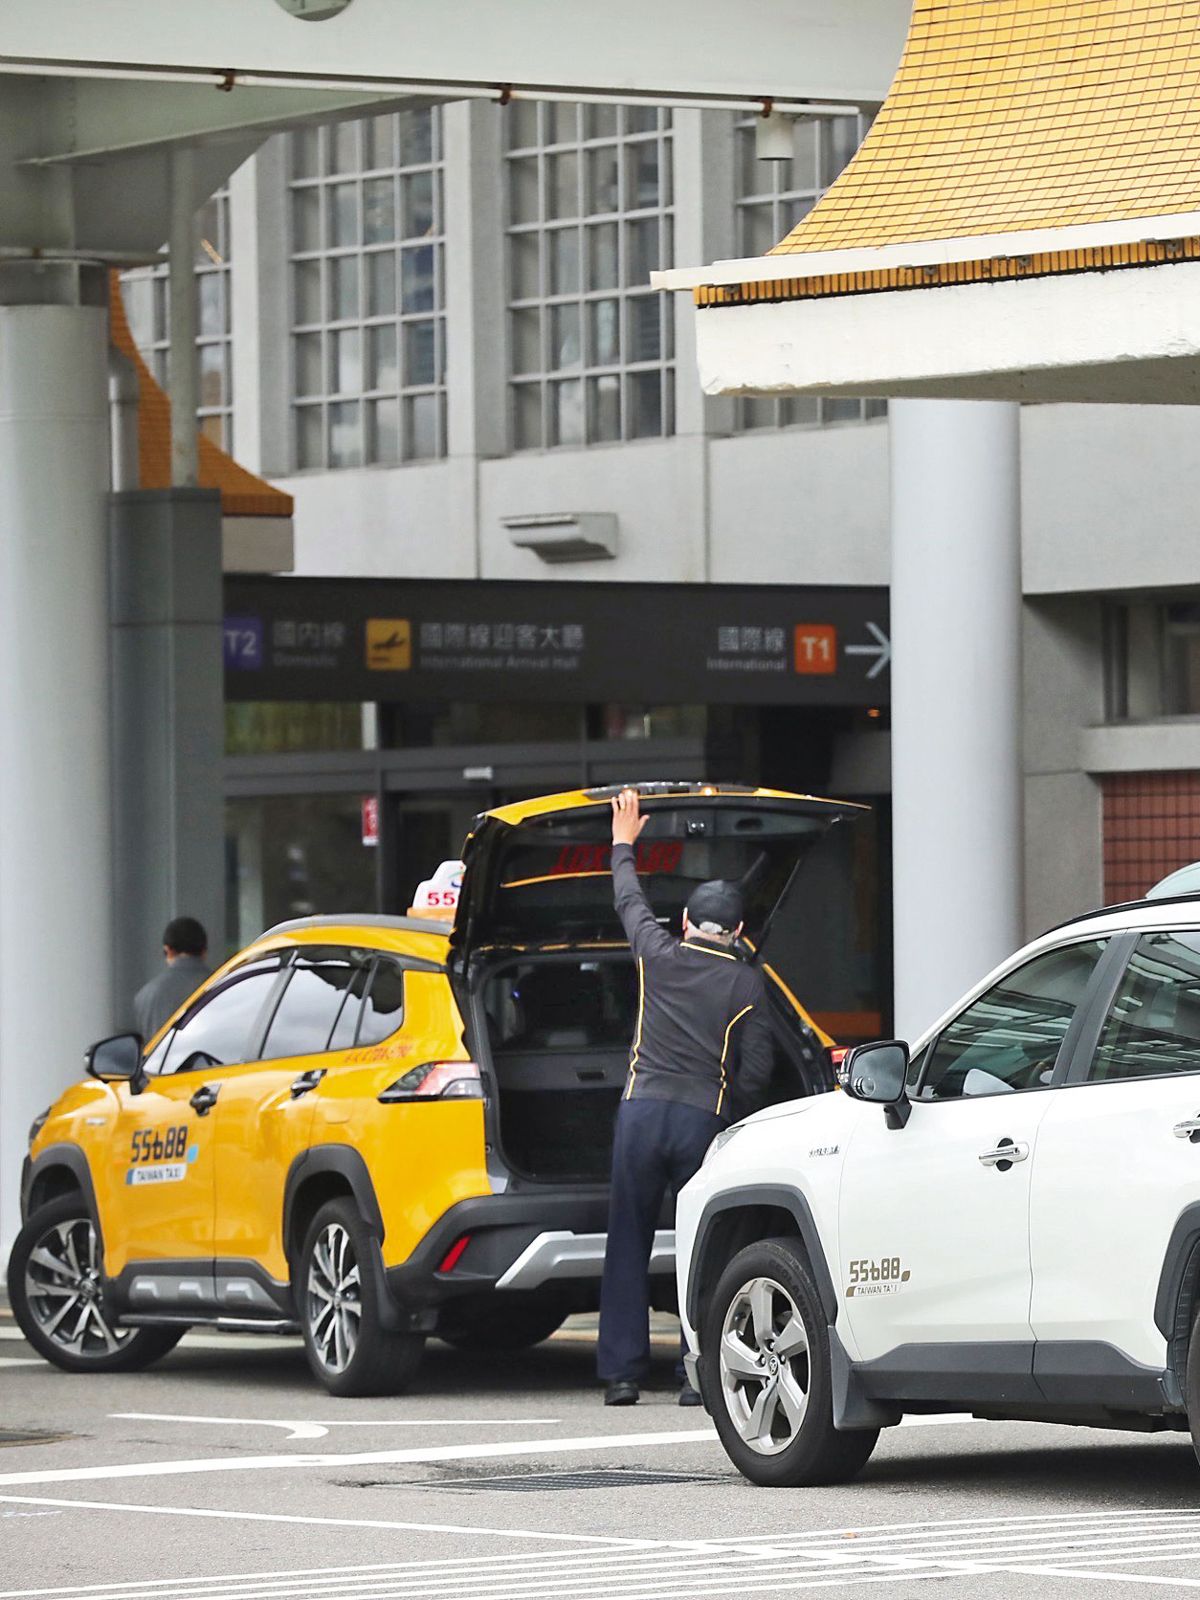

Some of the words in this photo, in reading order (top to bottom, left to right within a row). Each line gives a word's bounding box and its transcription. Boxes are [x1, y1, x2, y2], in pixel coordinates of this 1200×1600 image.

[225, 631, 257, 656] T2
[718, 626, 786, 652] 國際線
[801, 636, 832, 662] T1
[420, 655, 502, 669] International
[506, 655, 550, 669] Arrival
[553, 655, 579, 669] Hall
[706, 657, 786, 671] International
[428, 891, 456, 906] 55
[131, 1126, 188, 1163] 55688
[849, 1257, 901, 1283] 55688
[857, 1285, 882, 1296] TAIWAN
